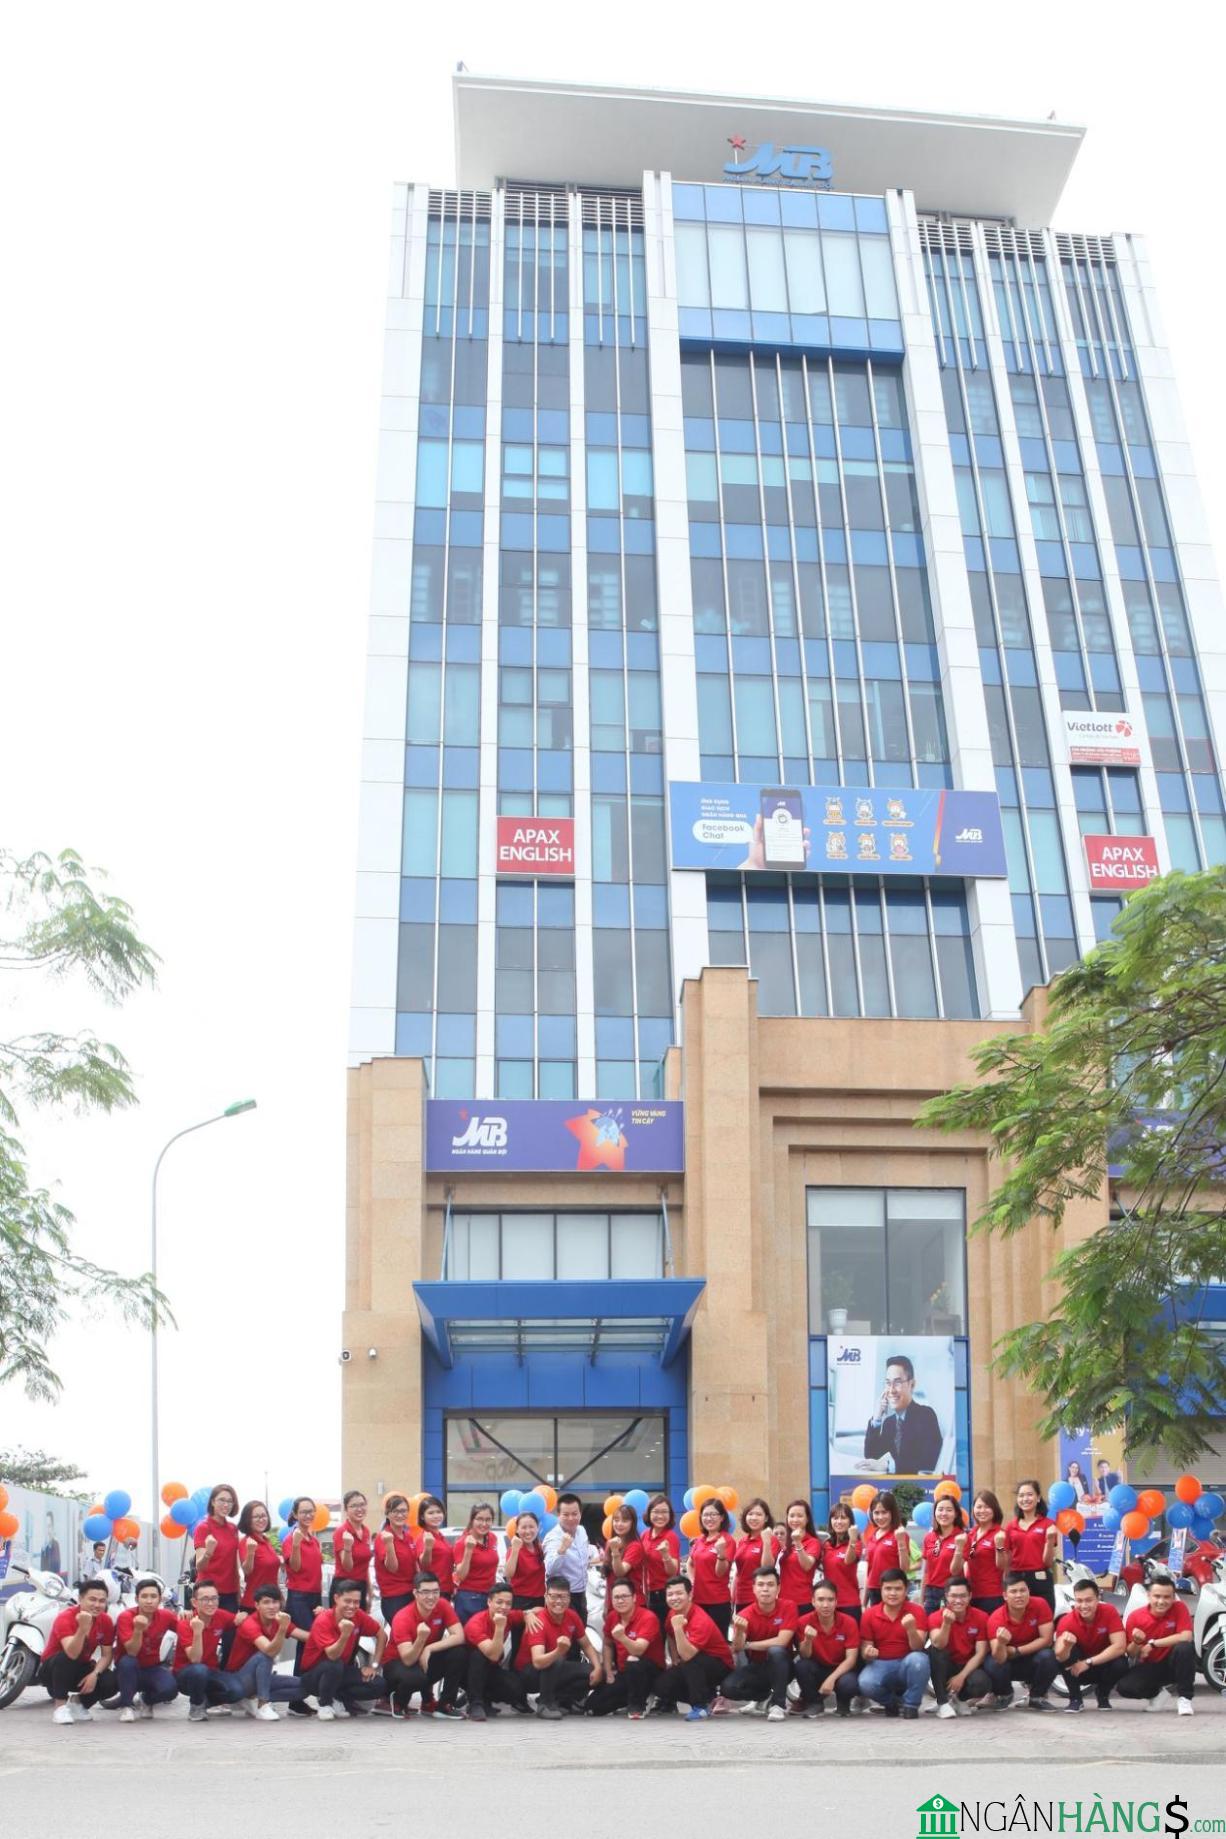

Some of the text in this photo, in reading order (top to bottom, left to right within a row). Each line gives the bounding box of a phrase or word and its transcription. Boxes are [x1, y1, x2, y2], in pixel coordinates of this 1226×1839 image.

[723, 142, 833, 180] MB
[1067, 722, 1113, 733] Vietlott
[702, 823, 745, 832] Facebook
[702, 831, 725, 840] Chat
[955, 828, 982, 840] MB
[513, 828, 560, 844] APAX
[499, 845, 572, 863] ENGLISH
[1102, 846, 1144, 862] APAX
[1091, 862, 1159, 879] ENGLISH
[452, 1116, 508, 1147] MB
[836, 1347, 862, 1362] MB
